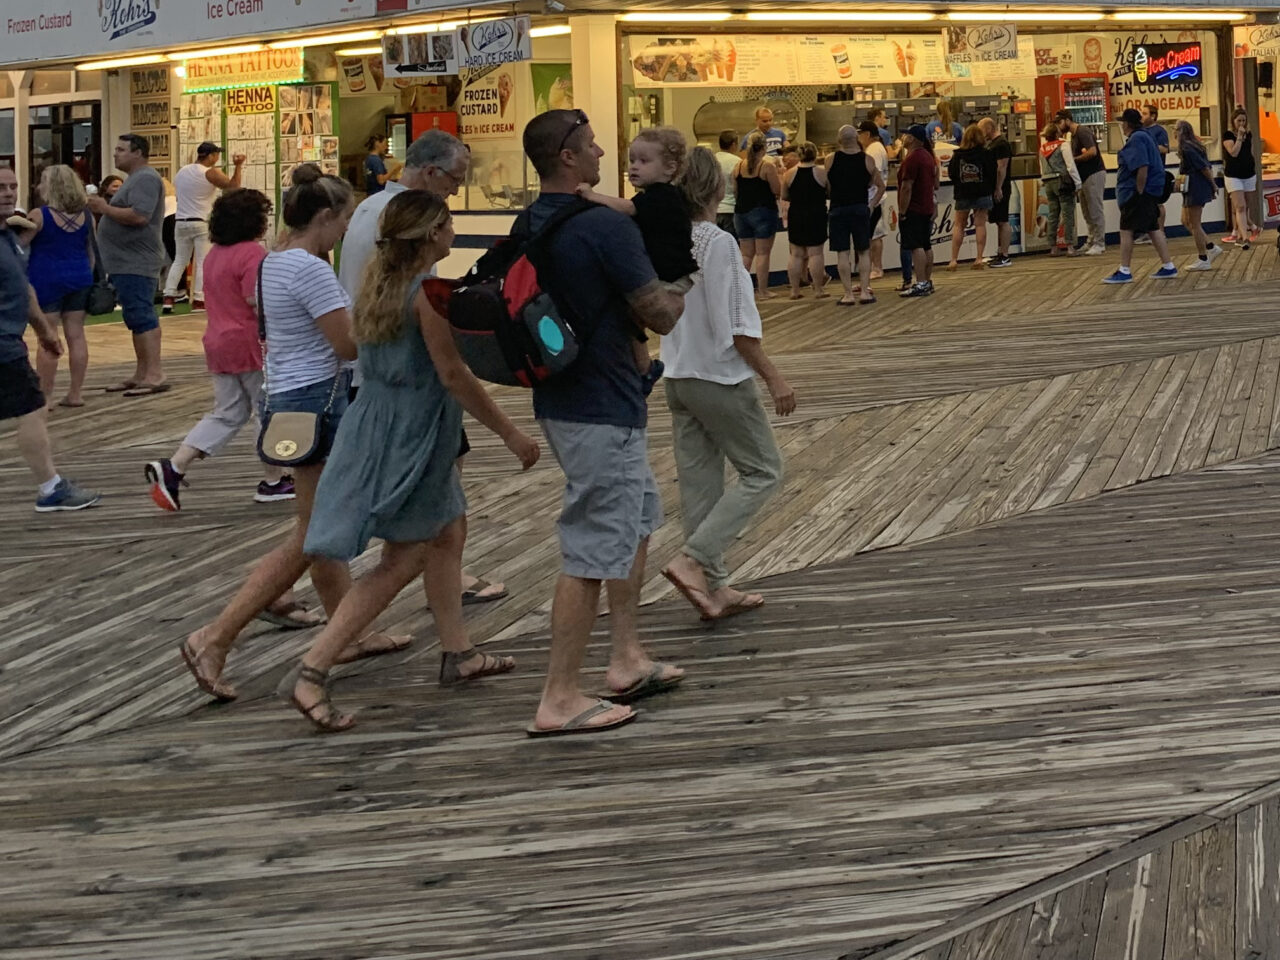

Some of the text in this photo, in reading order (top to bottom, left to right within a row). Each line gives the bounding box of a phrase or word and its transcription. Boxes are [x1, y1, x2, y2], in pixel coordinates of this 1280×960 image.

[207, 2, 223, 19] Ice
[7, 10, 72, 34] Frozen Custard
[465, 49, 524, 67] HARD ICE CREAM
[945, 53, 971, 64] WAFFLES
[981, 52, 992, 62] ICE
[994, 50, 1017, 61] CREAM
[1251, 48, 1276, 57] ITALIAN
[188, 48, 300, 77] HENNA TATTOOS
[1149, 46, 1200, 75] Ice Cream
[227, 86, 274, 106] HENNA
[464, 88, 498, 101] FROZEN
[228, 102, 274, 113] TATTOO
[460, 103, 498, 116] CUSTARD
[479, 124, 490, 134] ICE
[492, 123, 515, 133] CREAM
